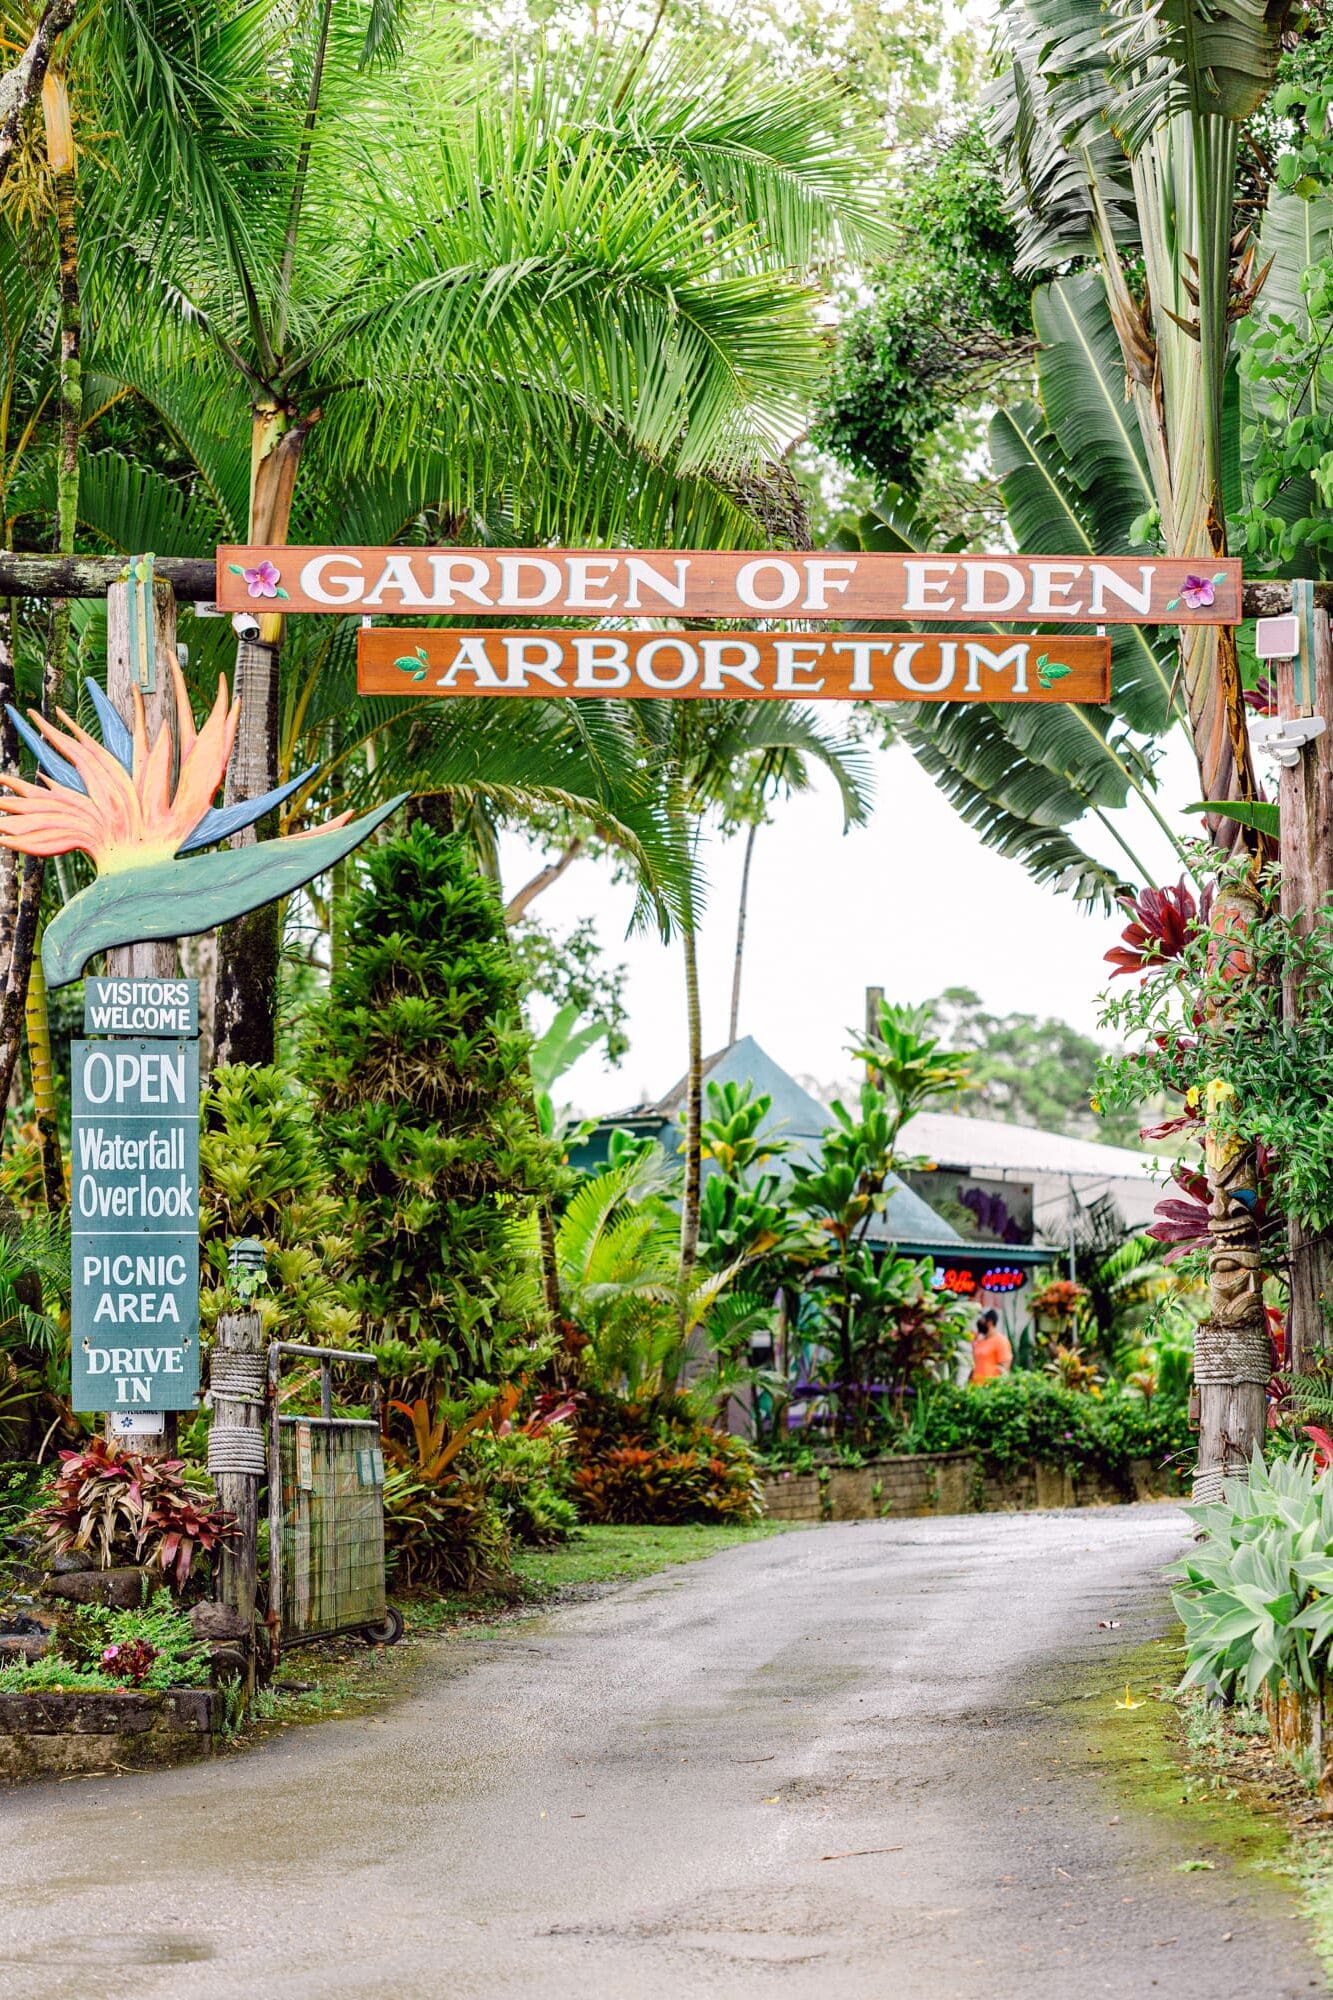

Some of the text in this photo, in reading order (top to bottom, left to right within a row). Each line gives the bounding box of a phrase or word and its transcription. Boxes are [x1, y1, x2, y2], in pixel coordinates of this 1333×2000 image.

[300, 554, 1158, 616] GARDEN OF EDEN
[436, 637, 1030, 694] ARBORETUM
[96, 982, 190, 1006] VISITORS
[89, 1006, 192, 1031] WELCOME
[83, 1052, 186, 1104] OPEN
[78, 1127, 185, 1170] Waterfall
[78, 1174, 195, 1218] Overlook
[83, 1255, 187, 1286] PICNIC
[93, 1292, 181, 1323] AREA
[86, 1347, 184, 1374] DRIVE
[114, 1376, 153, 1403] IN
